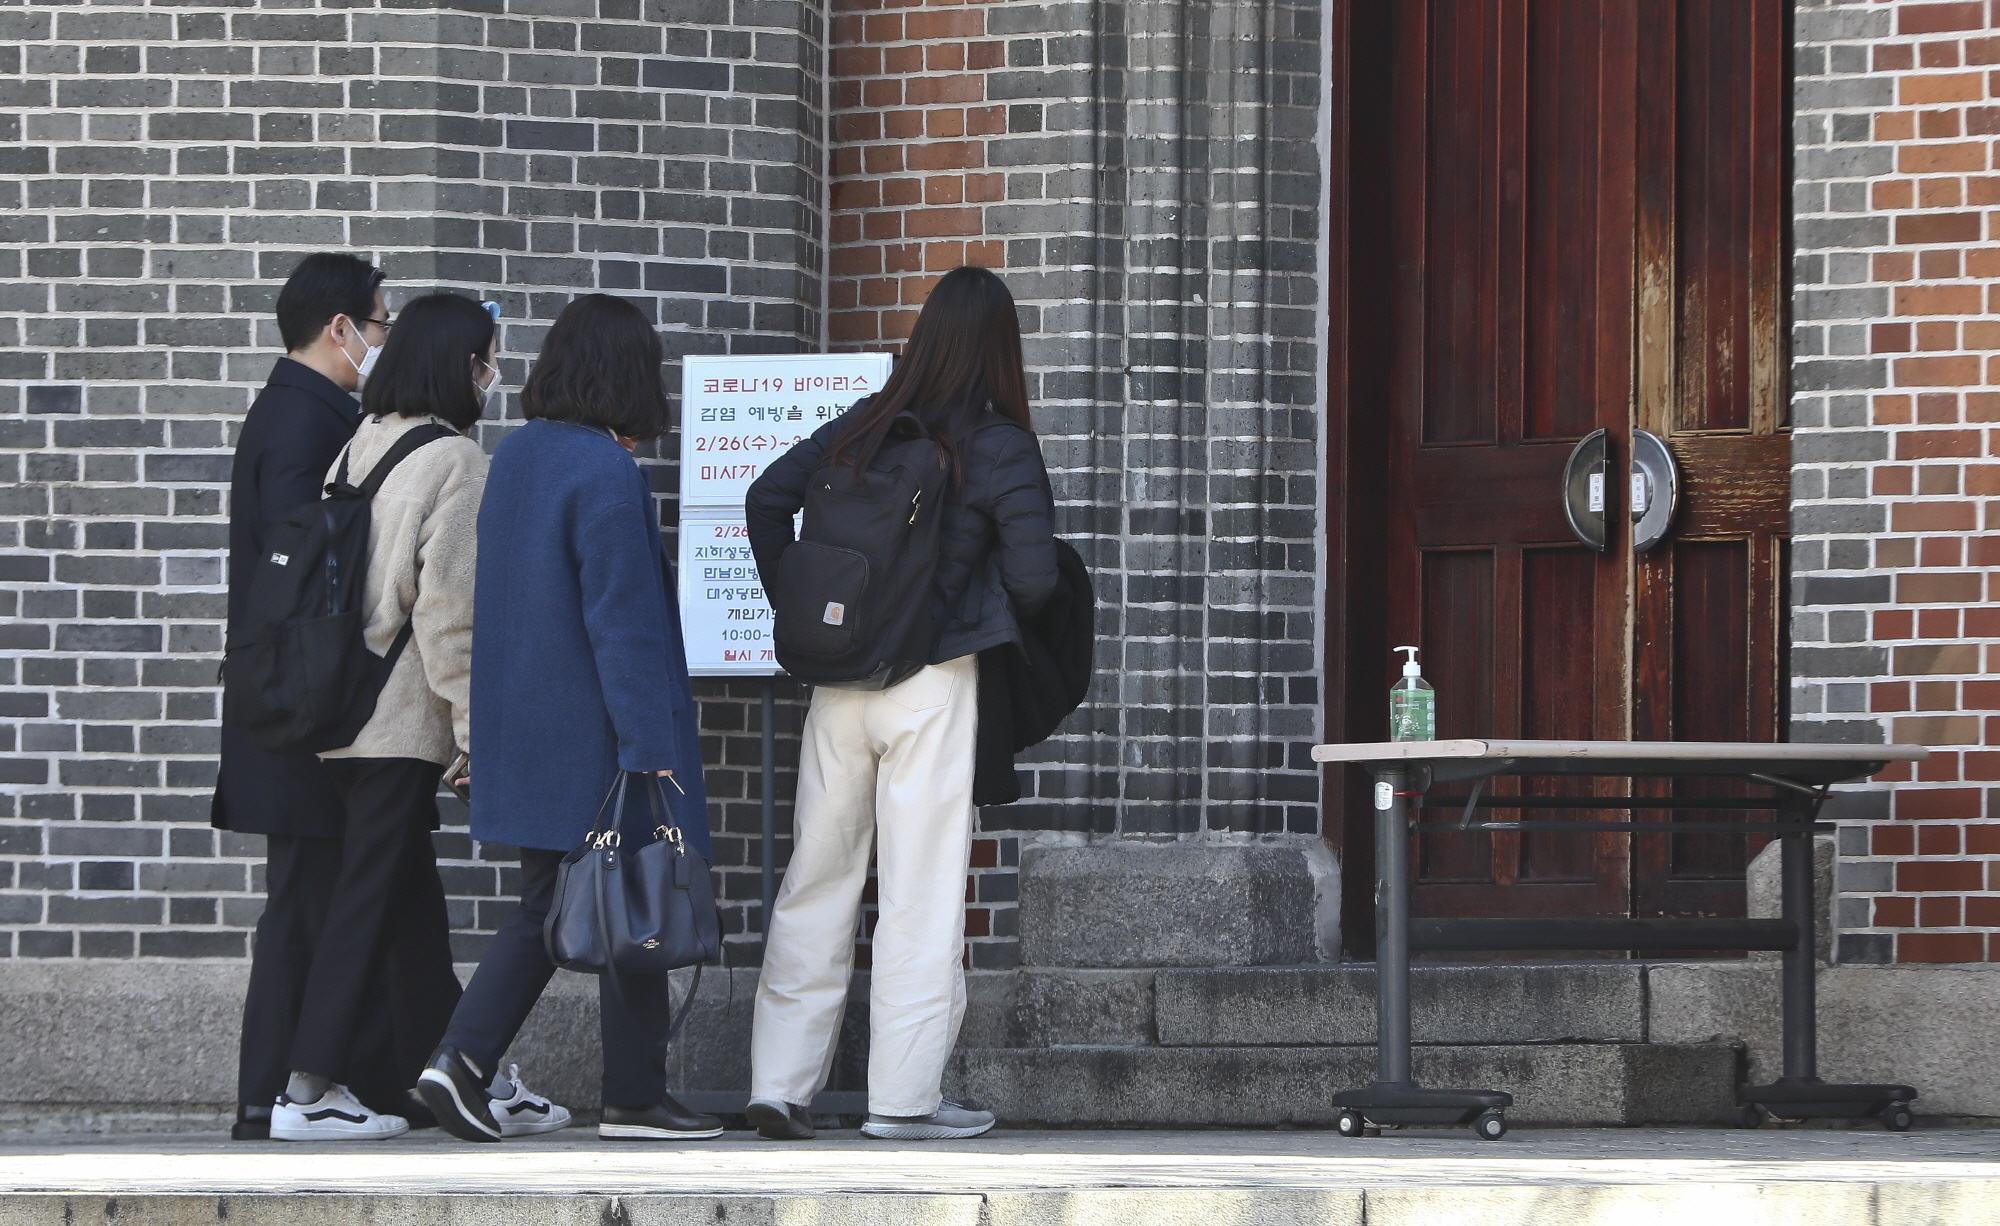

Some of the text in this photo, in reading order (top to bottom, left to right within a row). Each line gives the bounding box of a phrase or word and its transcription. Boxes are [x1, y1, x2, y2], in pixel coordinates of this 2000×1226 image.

[703, 375, 869, 393] 코로나19 바이러스
[700, 406, 736, 422] 감염
[748, 405, 803, 422] 예방을
[695, 545, 753, 559] 지하성당
[724, 649, 751, 662] 일시
